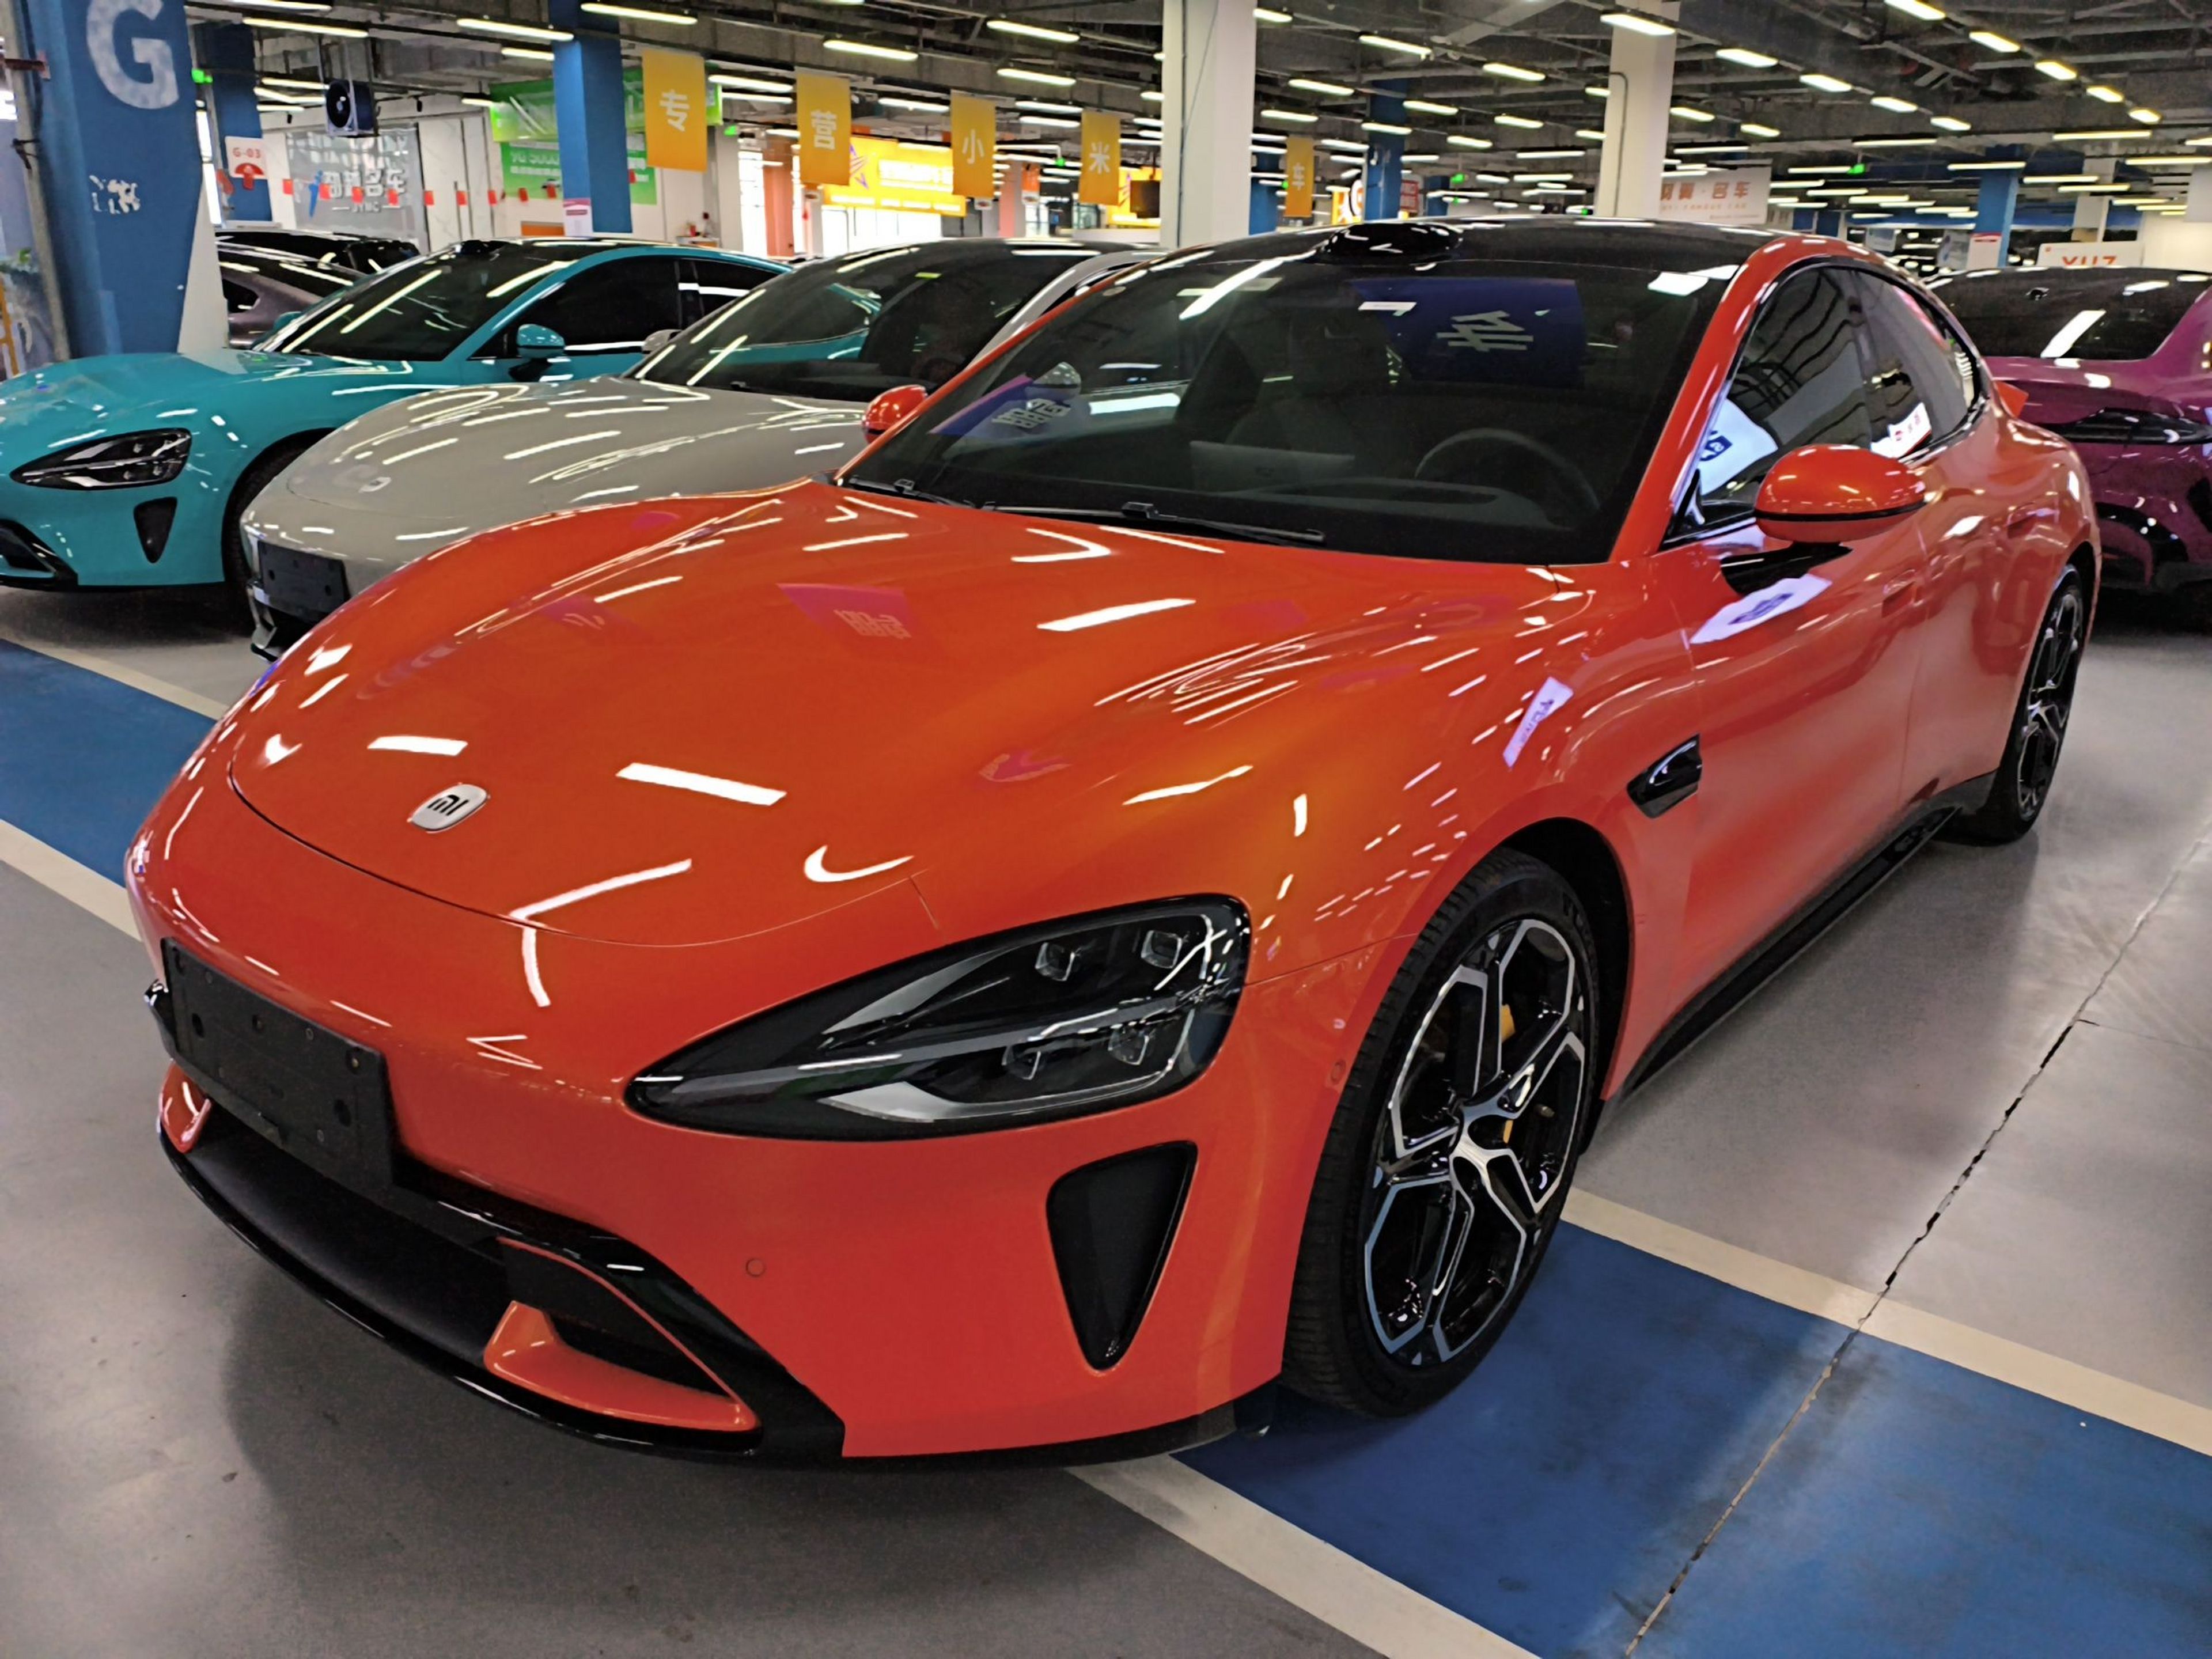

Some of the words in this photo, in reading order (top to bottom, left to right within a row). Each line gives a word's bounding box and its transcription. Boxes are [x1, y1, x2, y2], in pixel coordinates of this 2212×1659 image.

[86, 0, 179, 109] G
[658, 88, 690, 132] 专
[809, 109, 838, 151] 营
[962, 128, 985, 165] 小
[1088, 141, 1111, 174] 米
